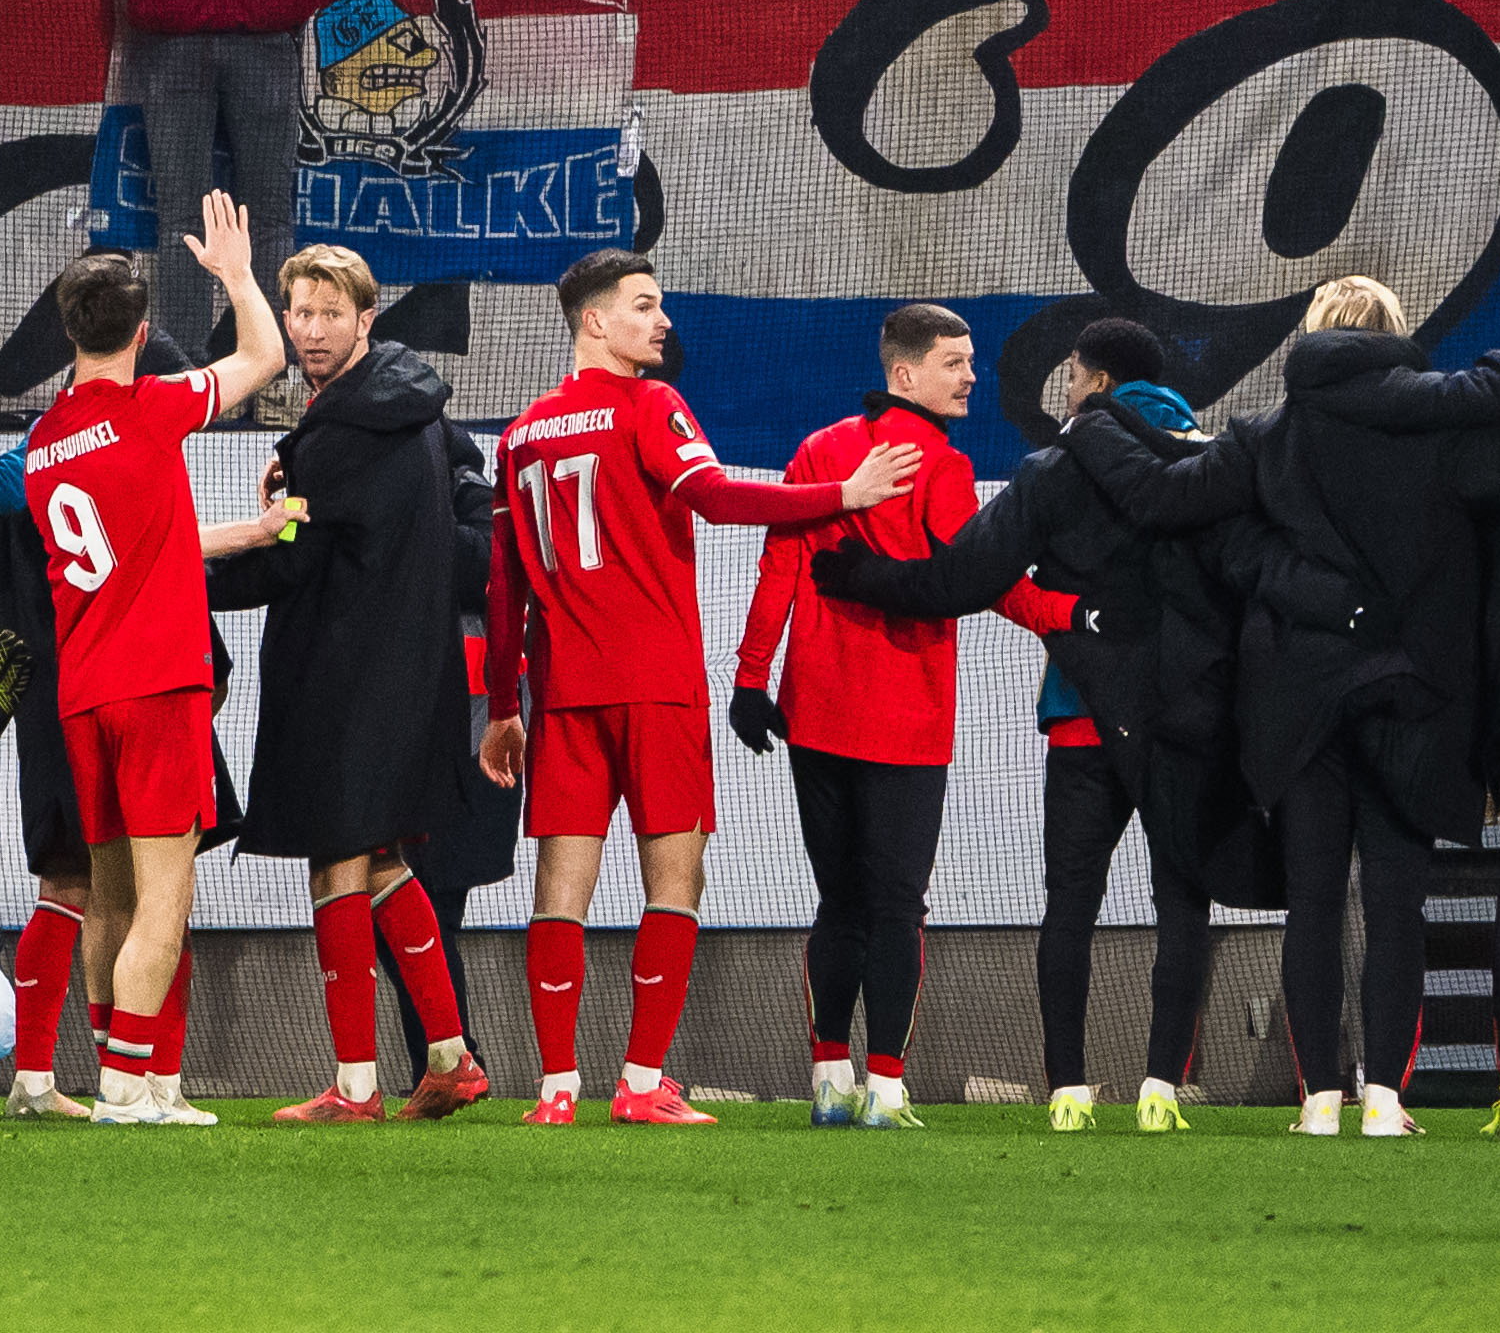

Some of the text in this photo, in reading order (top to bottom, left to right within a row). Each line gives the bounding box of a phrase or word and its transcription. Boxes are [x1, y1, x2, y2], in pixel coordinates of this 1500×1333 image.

[117, 124, 622, 240] HALKE
[26, 420, 121, 475] WOLFSWINKEL
[46, 481, 120, 593] 9
[517, 452, 603, 573] 17
